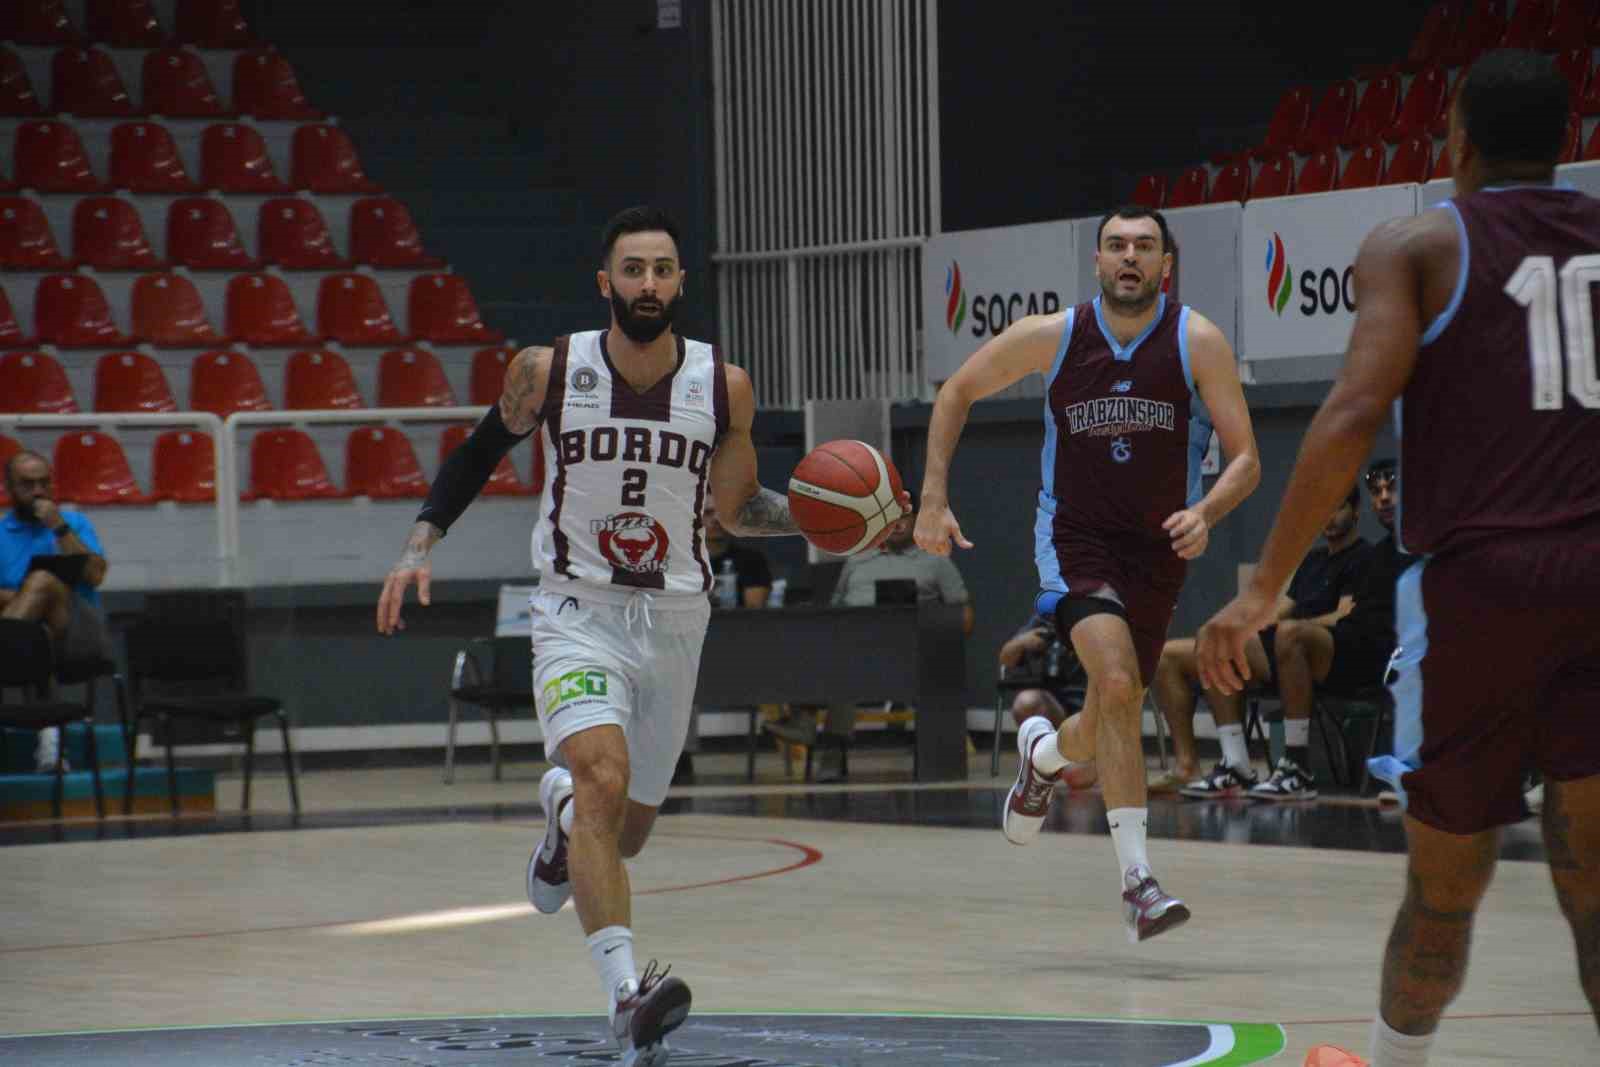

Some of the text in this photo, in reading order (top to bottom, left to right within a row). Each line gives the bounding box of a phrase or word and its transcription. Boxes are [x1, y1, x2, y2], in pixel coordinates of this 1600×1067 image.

[1300, 264, 1358, 316] SOC
[1066, 397, 1175, 434] TRABZONSPOR
[560, 427, 712, 475] BORDO
[621, 468, 648, 507] 2
